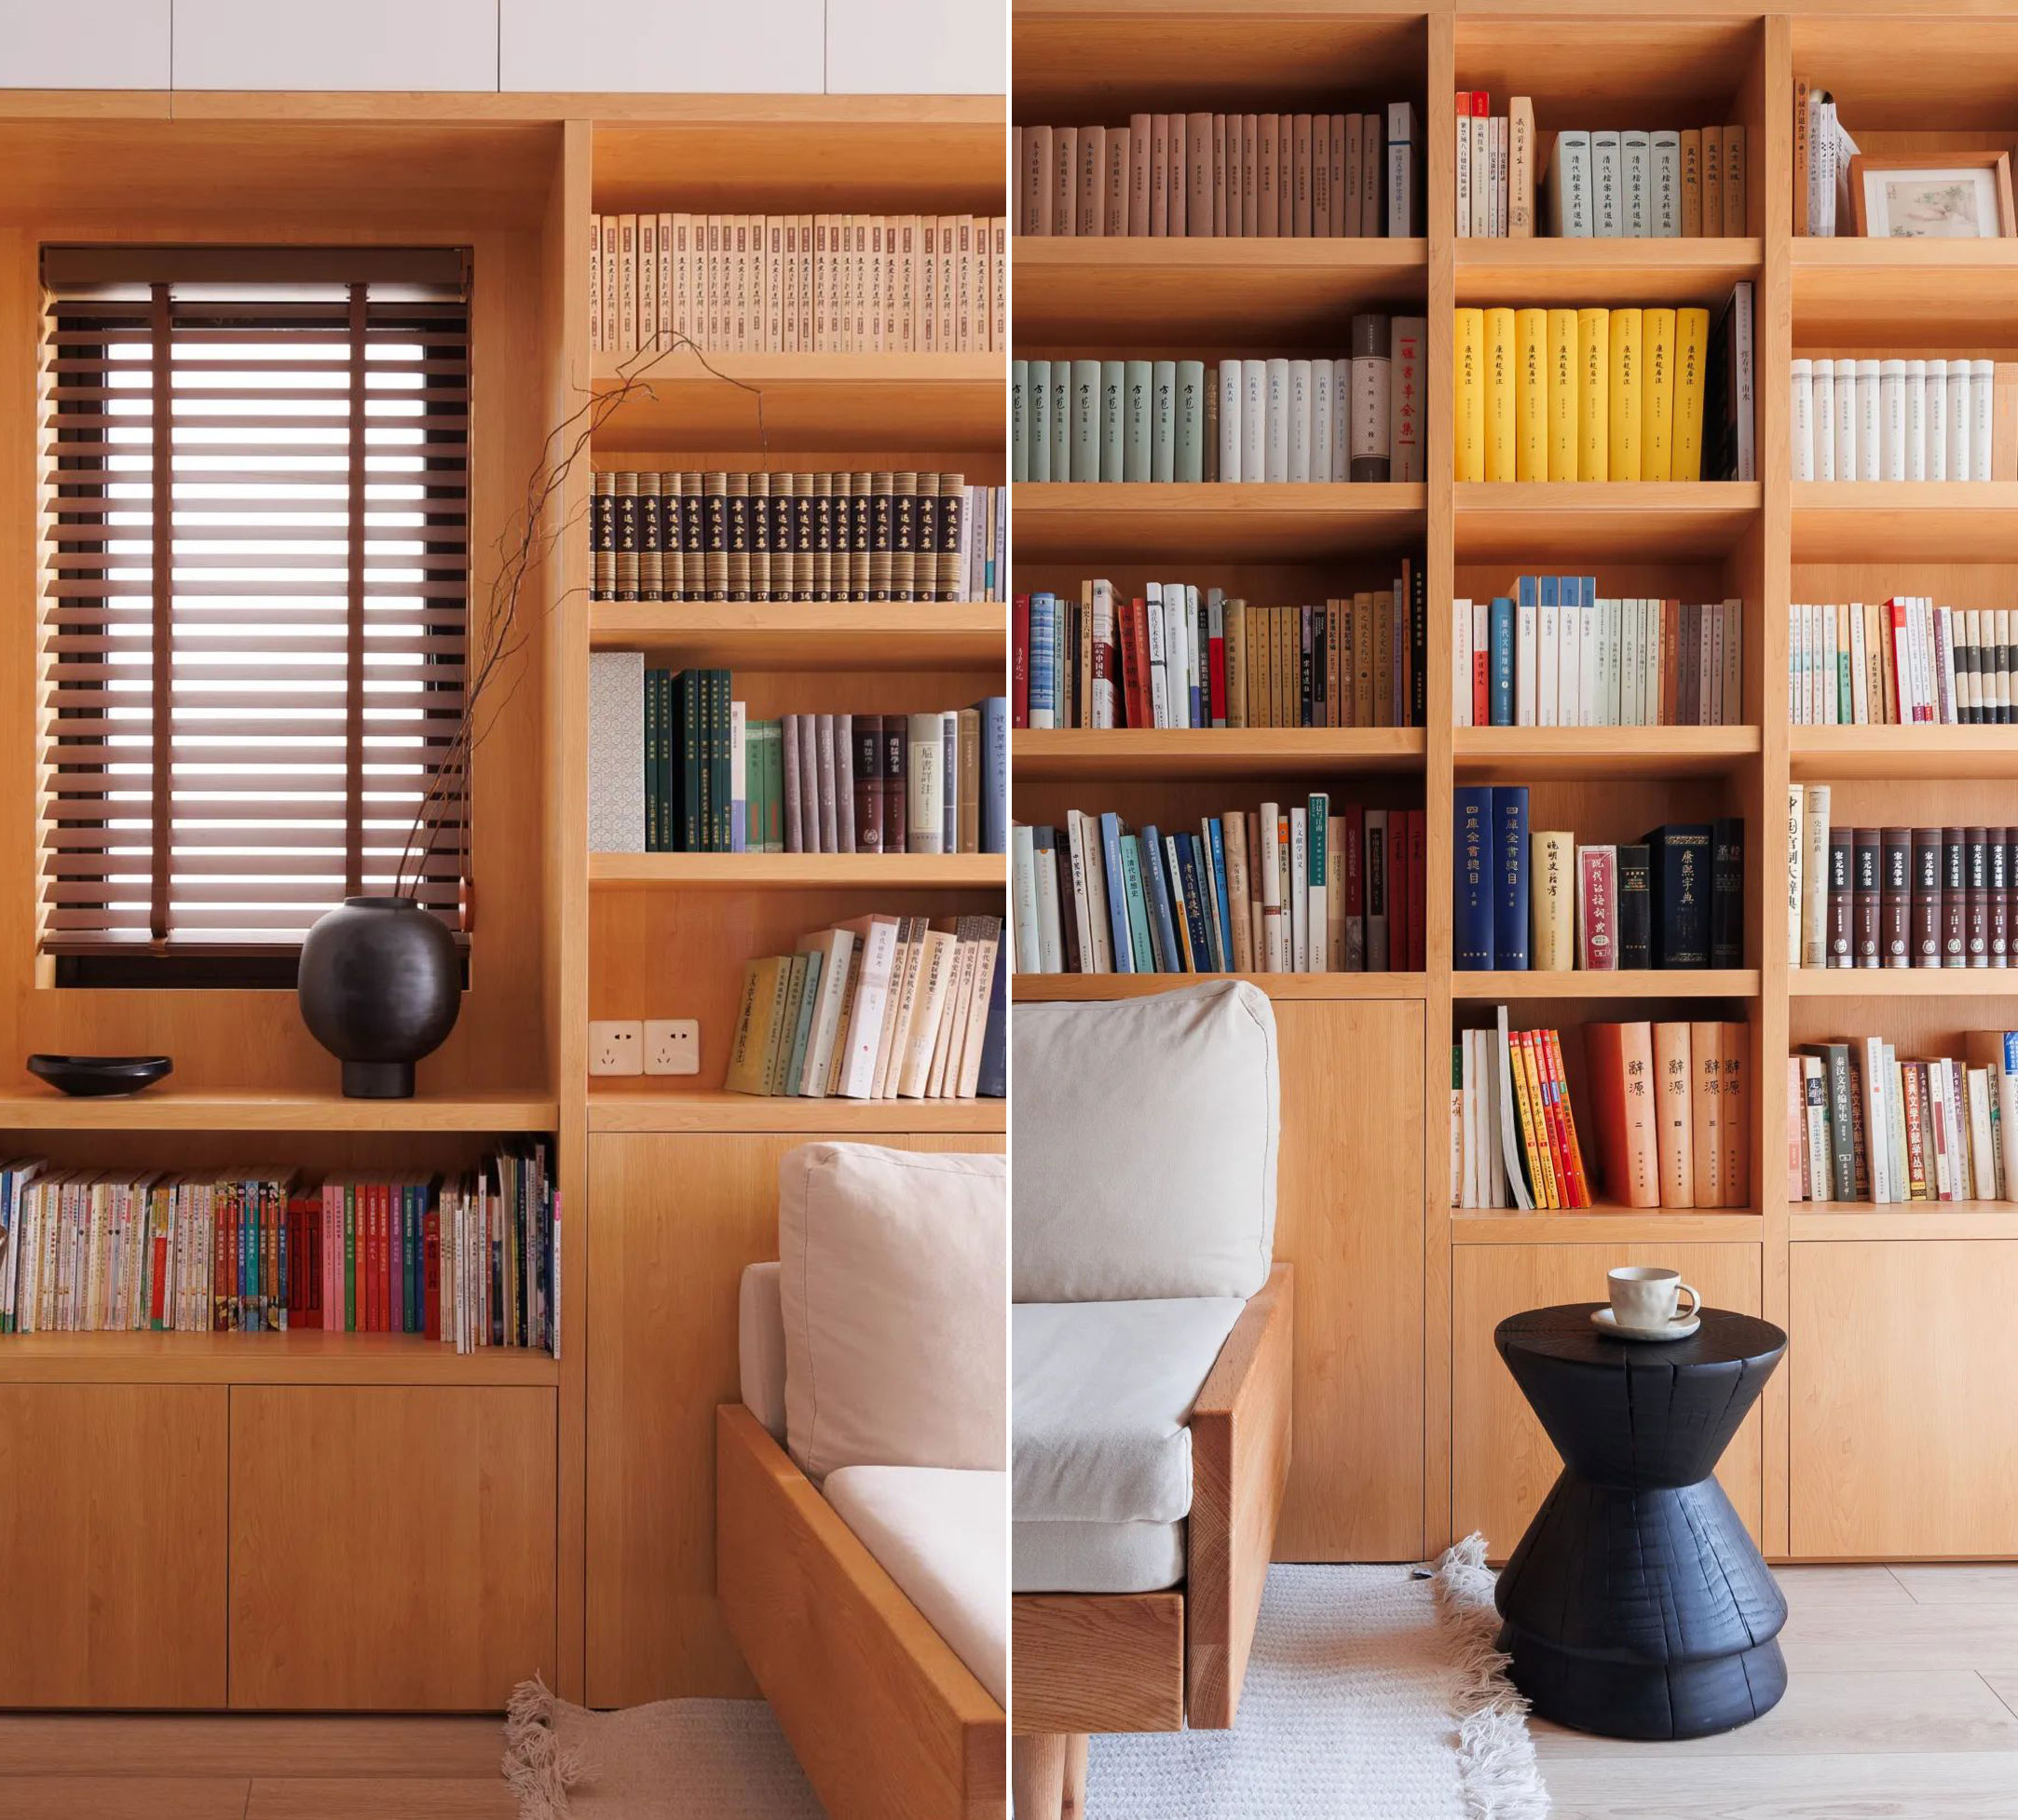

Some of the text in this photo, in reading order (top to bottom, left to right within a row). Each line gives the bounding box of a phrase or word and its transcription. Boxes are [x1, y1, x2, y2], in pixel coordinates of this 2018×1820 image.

[1466, 806, 1479, 884] 四庫全書總目
[1506, 807, 1519, 885] 四庫全書總目
[1547, 840, 1559, 897] 晚明史籍考
[1127, 859, 1139, 898] 清代思想史
[1681, 849, 1695, 905] 康熙字典
[1629, 1060, 1645, 1096] 辭源
[1669, 1059, 1684, 1095] 辭源
[1704, 1059, 1720, 1095] 辭源
[1724, 1059, 1740, 1095] 辭源
[1835, 1055, 1848, 1123] 秦汉文学编年史
[1850, 1068, 1863, 1180] 古典文学文献学丛稿
[1906, 1068, 1924, 1180] 古典文学文献学丛稿
